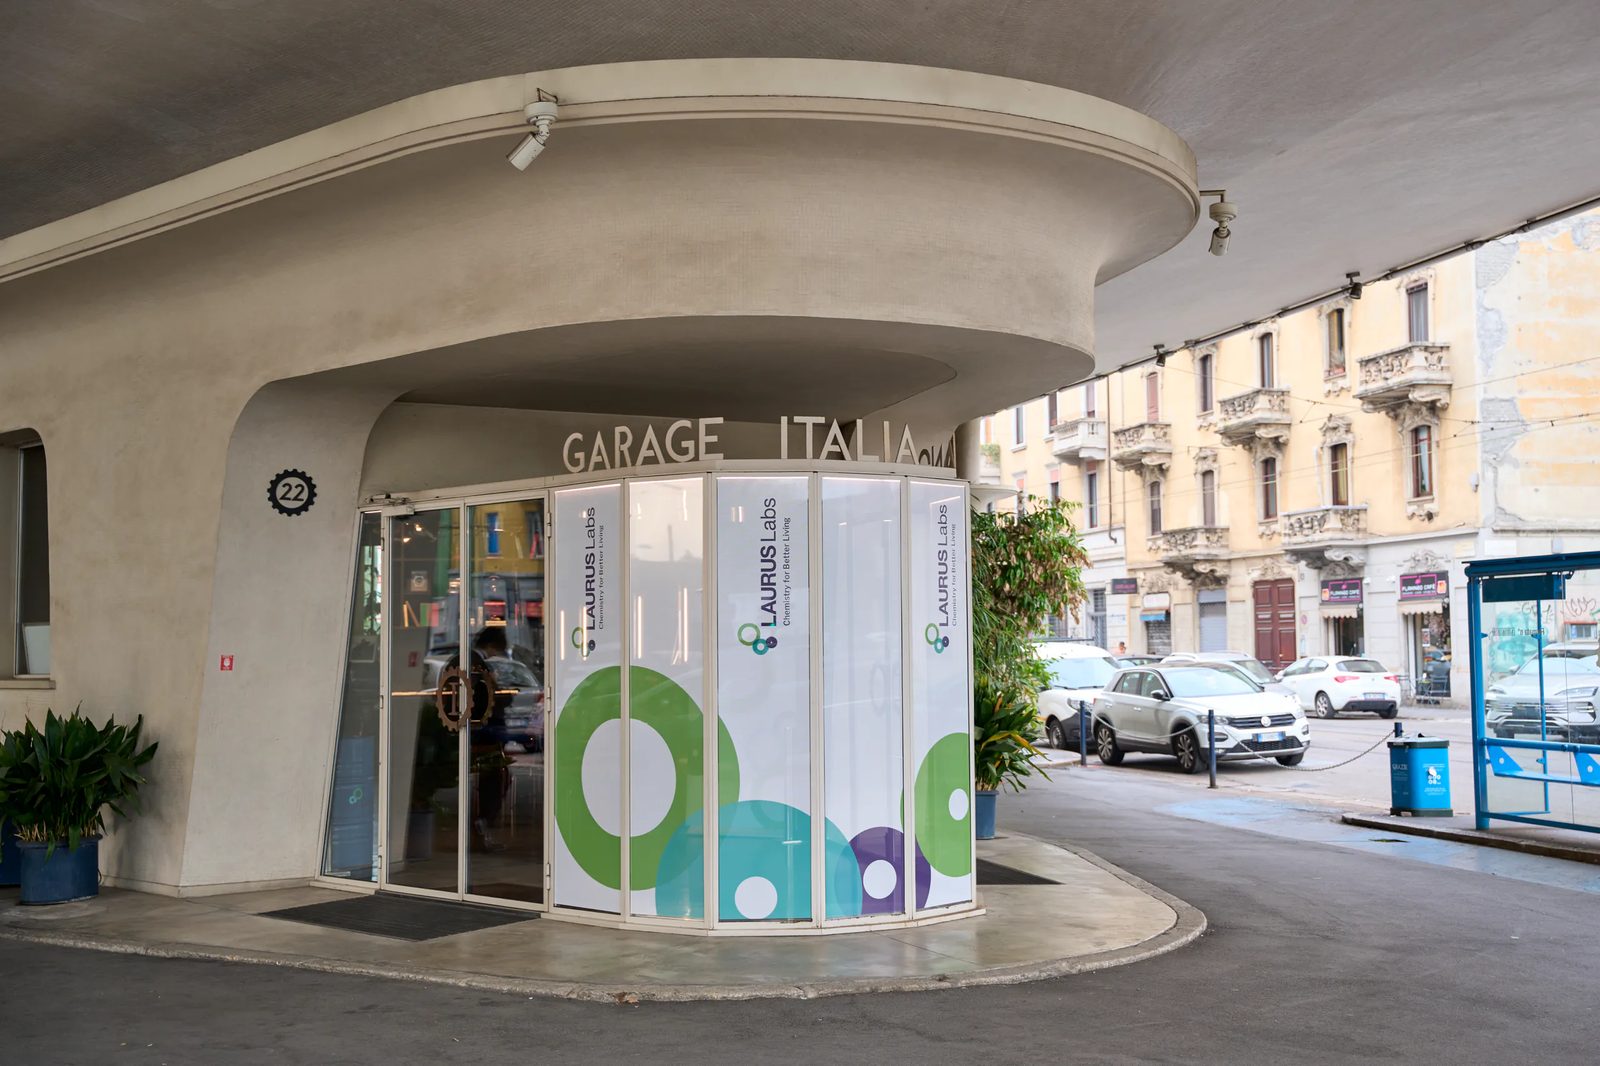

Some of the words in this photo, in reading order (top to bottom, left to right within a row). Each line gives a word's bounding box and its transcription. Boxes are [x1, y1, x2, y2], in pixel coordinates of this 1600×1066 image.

[563, 417, 724, 473] GARAGE
[780, 416, 920, 465] ITALIA
[279, 482, 305, 502] 22
[585, 507, 596, 549] Labs
[760, 497, 777, 542] Labs
[783, 517, 792, 542] Living
[938, 504, 948, 546] Labs
[783, 543, 791, 570] Better
[783, 571, 791, 581] for
[585, 552, 596, 630] LAURUS
[760, 545, 777, 627] LAURUS
[783, 582, 792, 627] Chemistry
[938, 549, 949, 627] LAURUS
